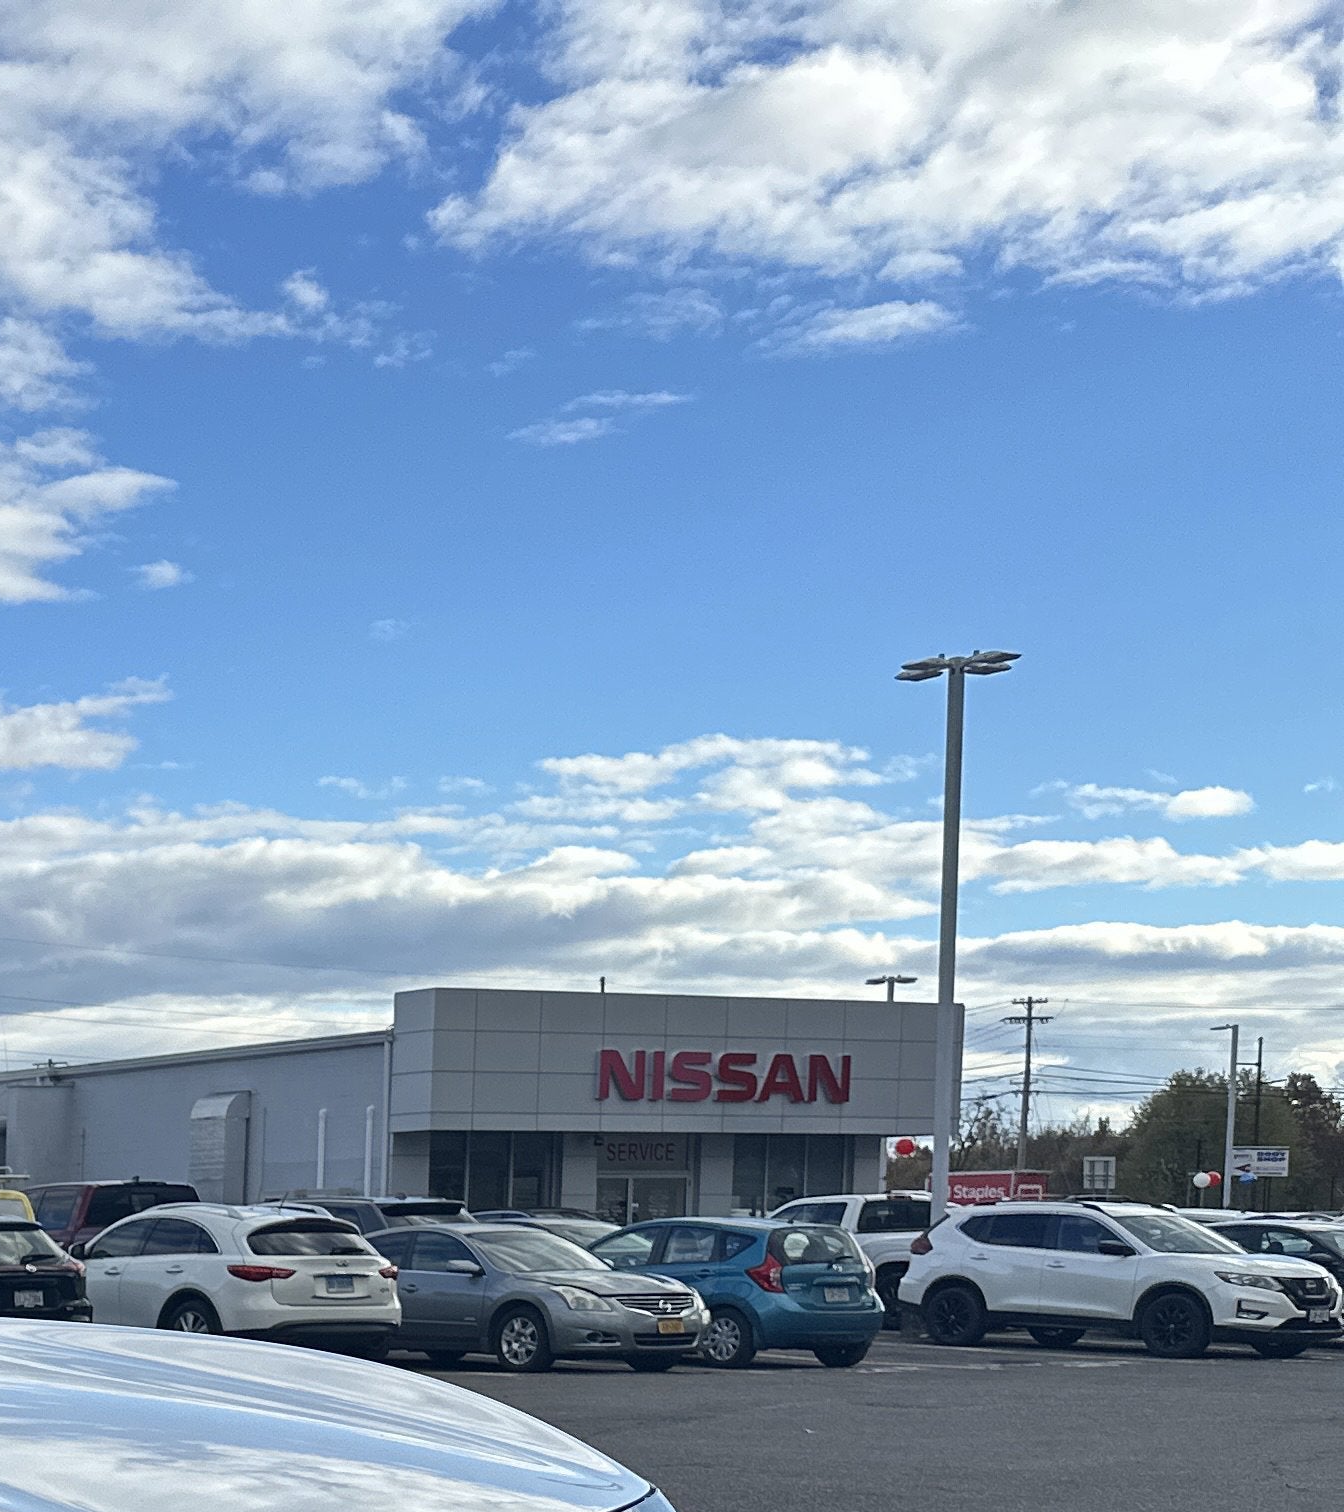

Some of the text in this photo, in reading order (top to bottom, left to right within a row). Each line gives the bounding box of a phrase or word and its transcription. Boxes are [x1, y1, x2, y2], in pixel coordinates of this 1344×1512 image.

[597, 1049, 852, 1104] NISSAN
[606, 1143, 675, 1162] SERVICE
[953, 1184, 1006, 1202] Staples
